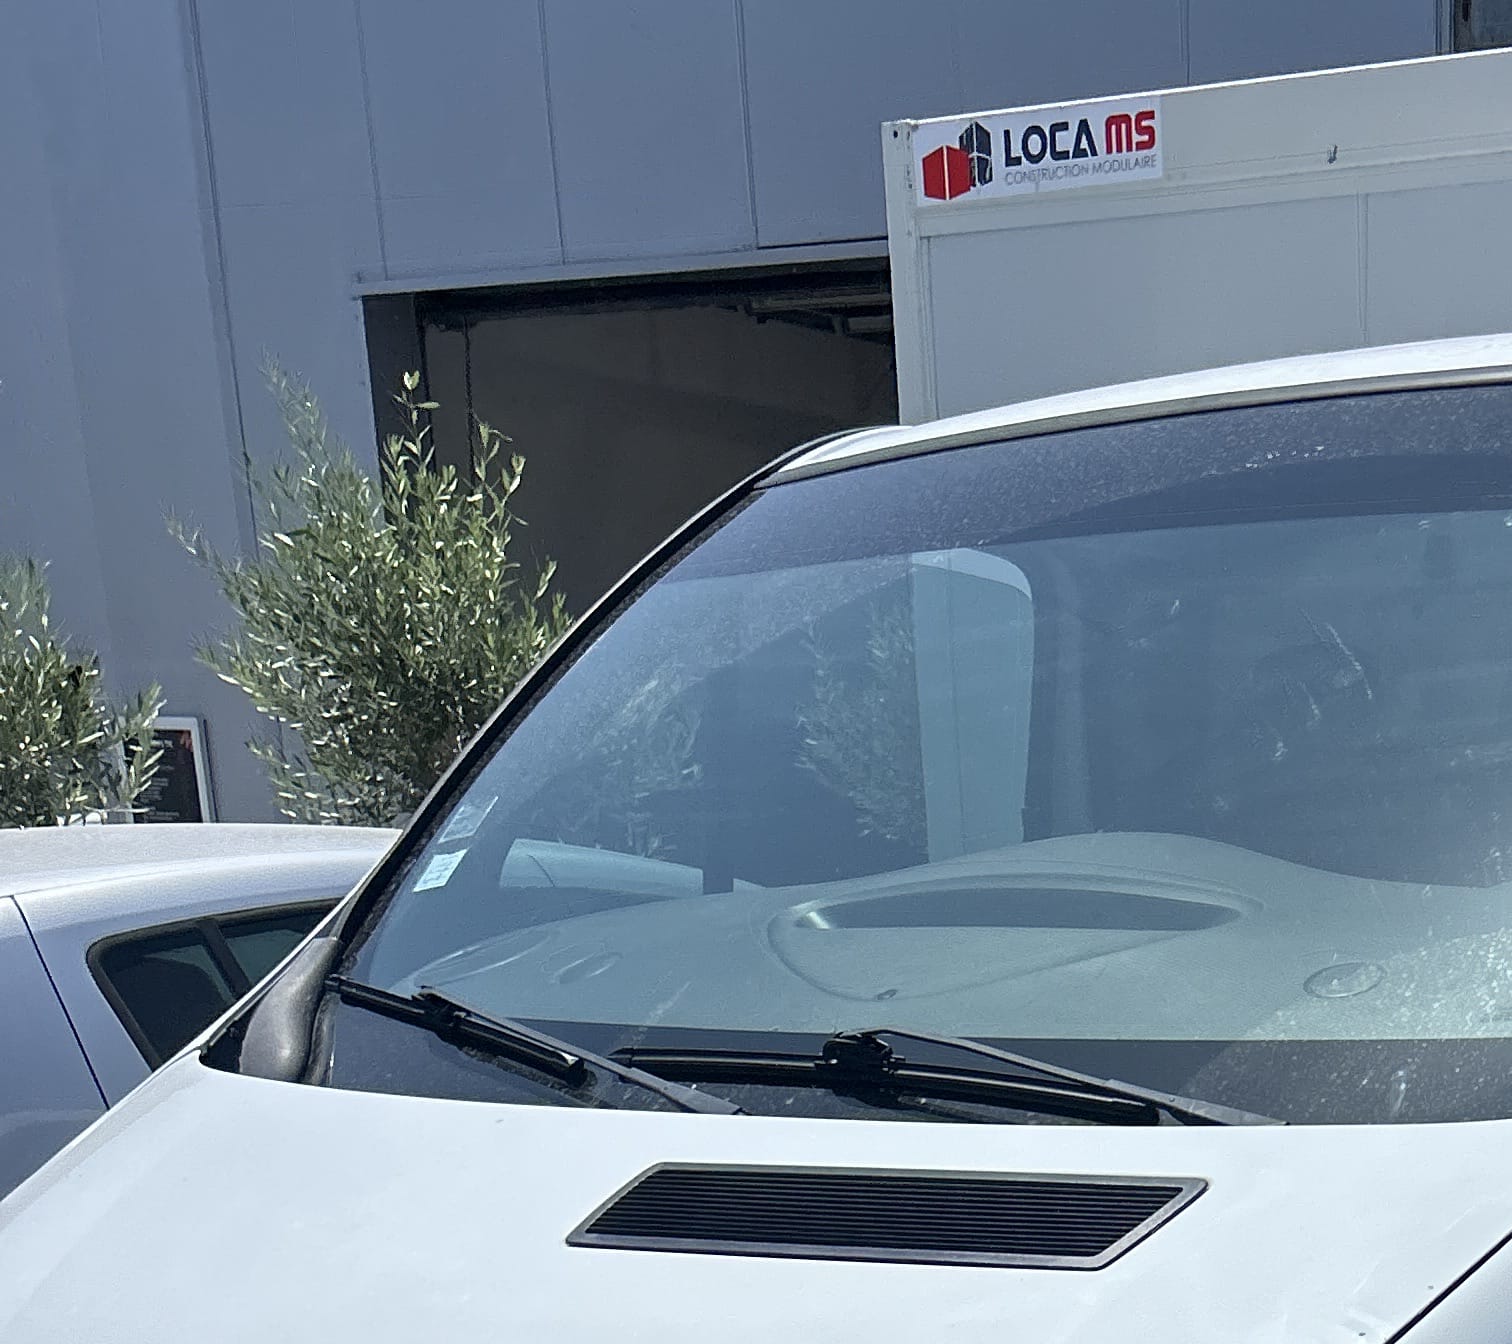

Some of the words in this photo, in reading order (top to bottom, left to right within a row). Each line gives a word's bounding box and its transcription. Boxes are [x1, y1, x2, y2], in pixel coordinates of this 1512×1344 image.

[1003, 118, 1099, 168] LOCA
[1105, 110, 1156, 156] MS
[1004, 163, 1090, 186] CONSTRUCTION
[1092, 154, 1158, 177] MODULAIRE
